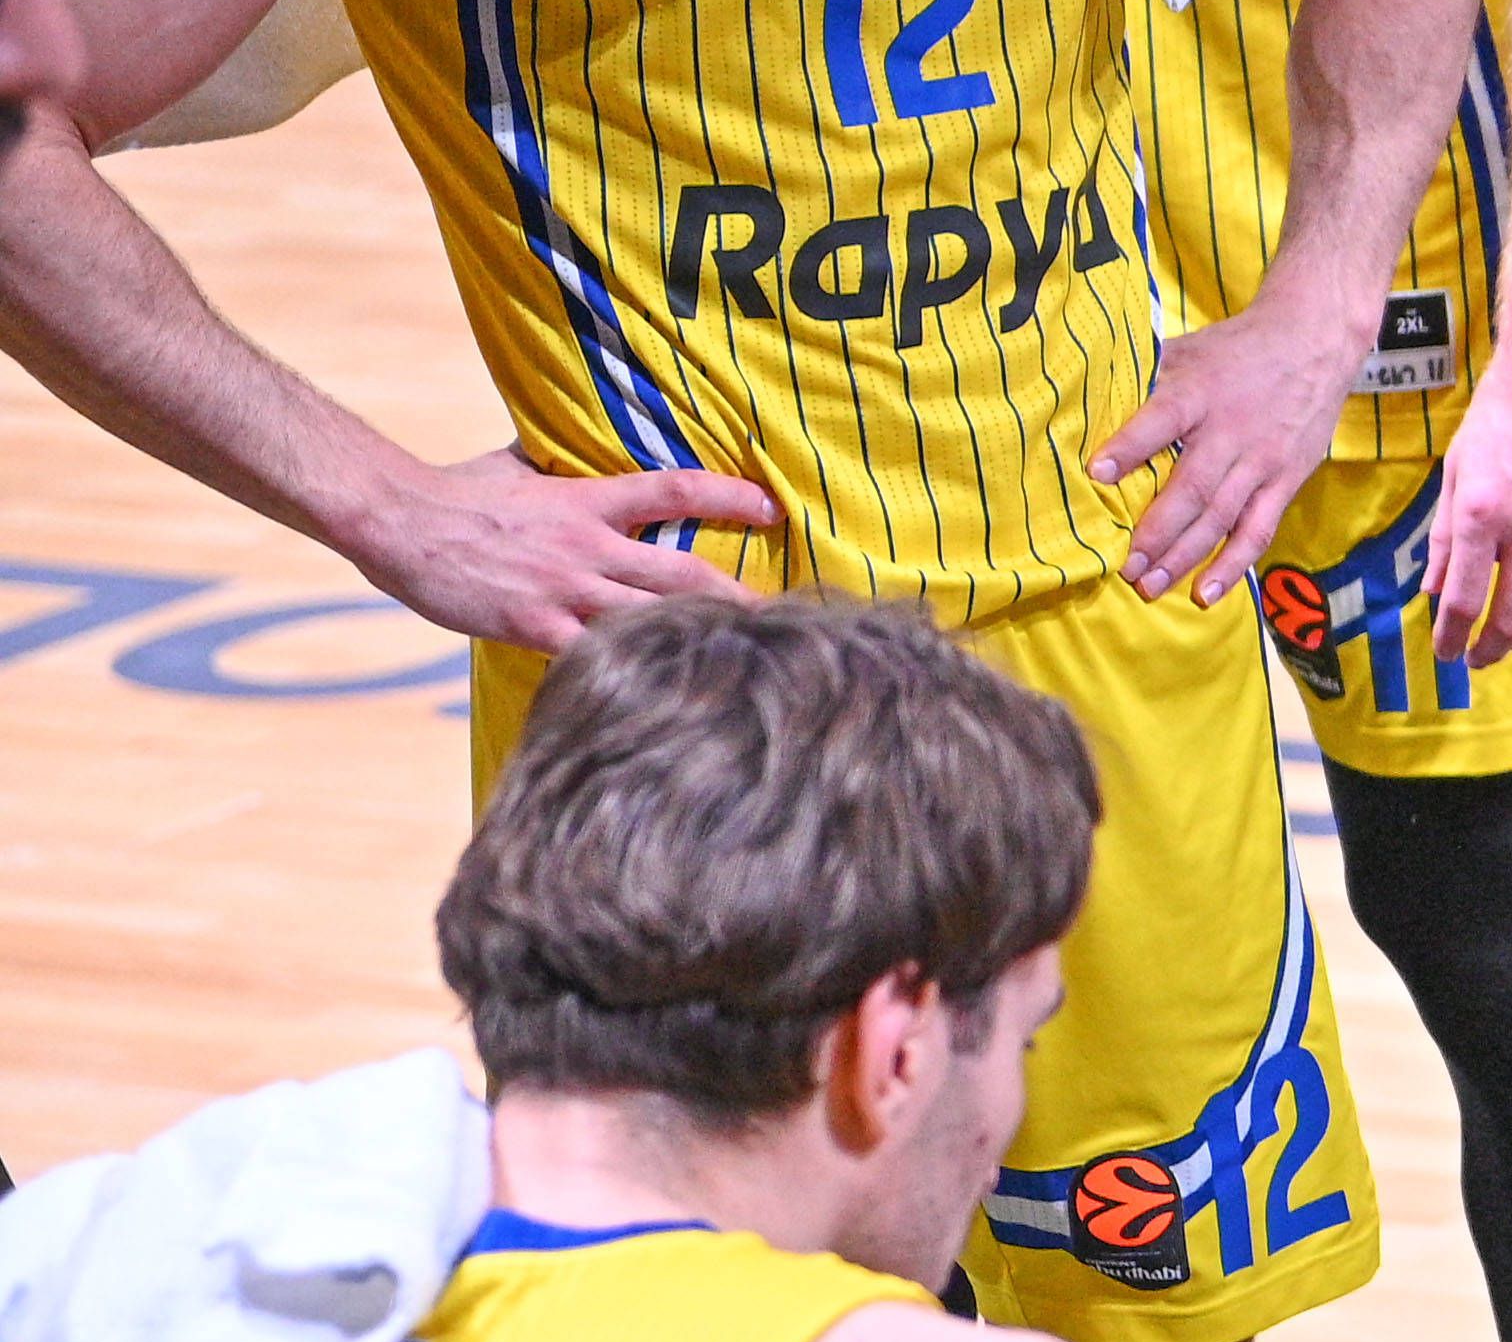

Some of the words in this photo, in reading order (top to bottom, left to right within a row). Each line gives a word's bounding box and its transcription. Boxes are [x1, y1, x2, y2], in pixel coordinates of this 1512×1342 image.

[668, 164, 1121, 349] Rapyd
[1396, 316, 1429, 336] 2XL
[1194, 1044, 1352, 1277] 12
[1125, 1264, 1182, 1280] dhabi
